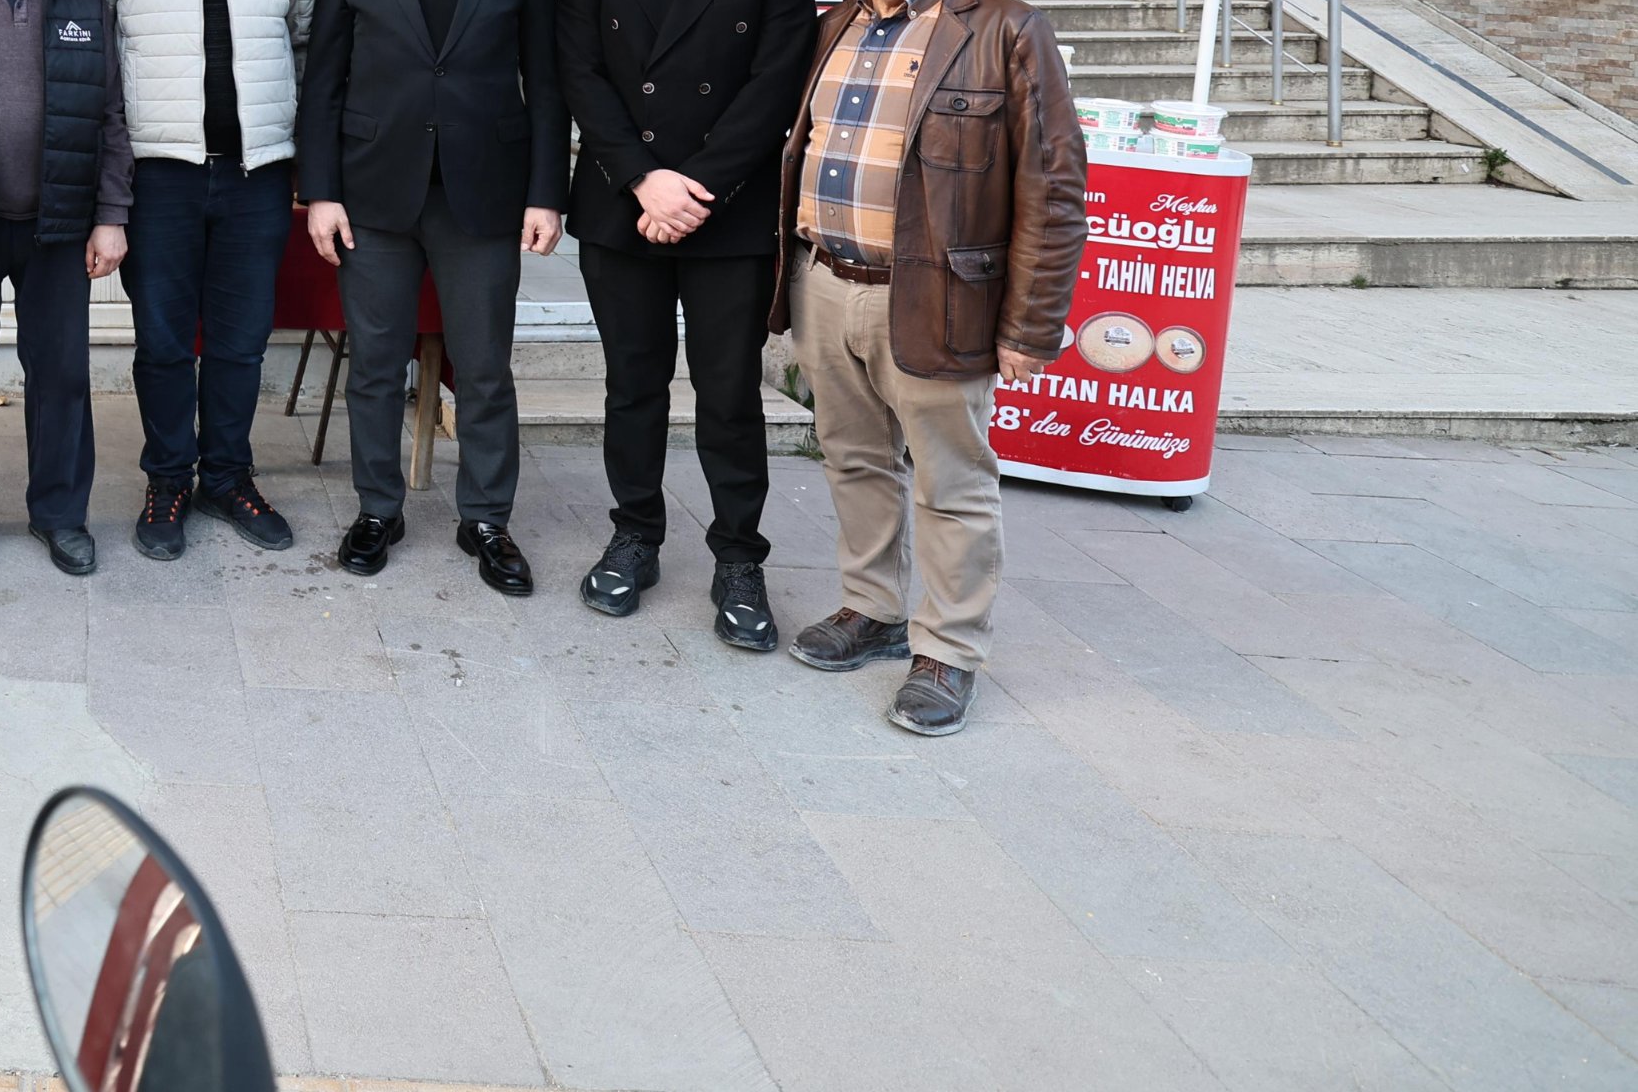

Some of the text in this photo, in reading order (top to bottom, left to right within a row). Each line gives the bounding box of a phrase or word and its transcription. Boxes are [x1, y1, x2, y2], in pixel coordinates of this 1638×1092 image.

[1087, 213, 1216, 253] cüoğlu
[1097, 254, 1155, 295] TAHİN
[1160, 265, 1215, 300] HELVA
[996, 372, 1195, 414] LATTAN HALKA
[1079, 418, 1191, 459] Günümüze
